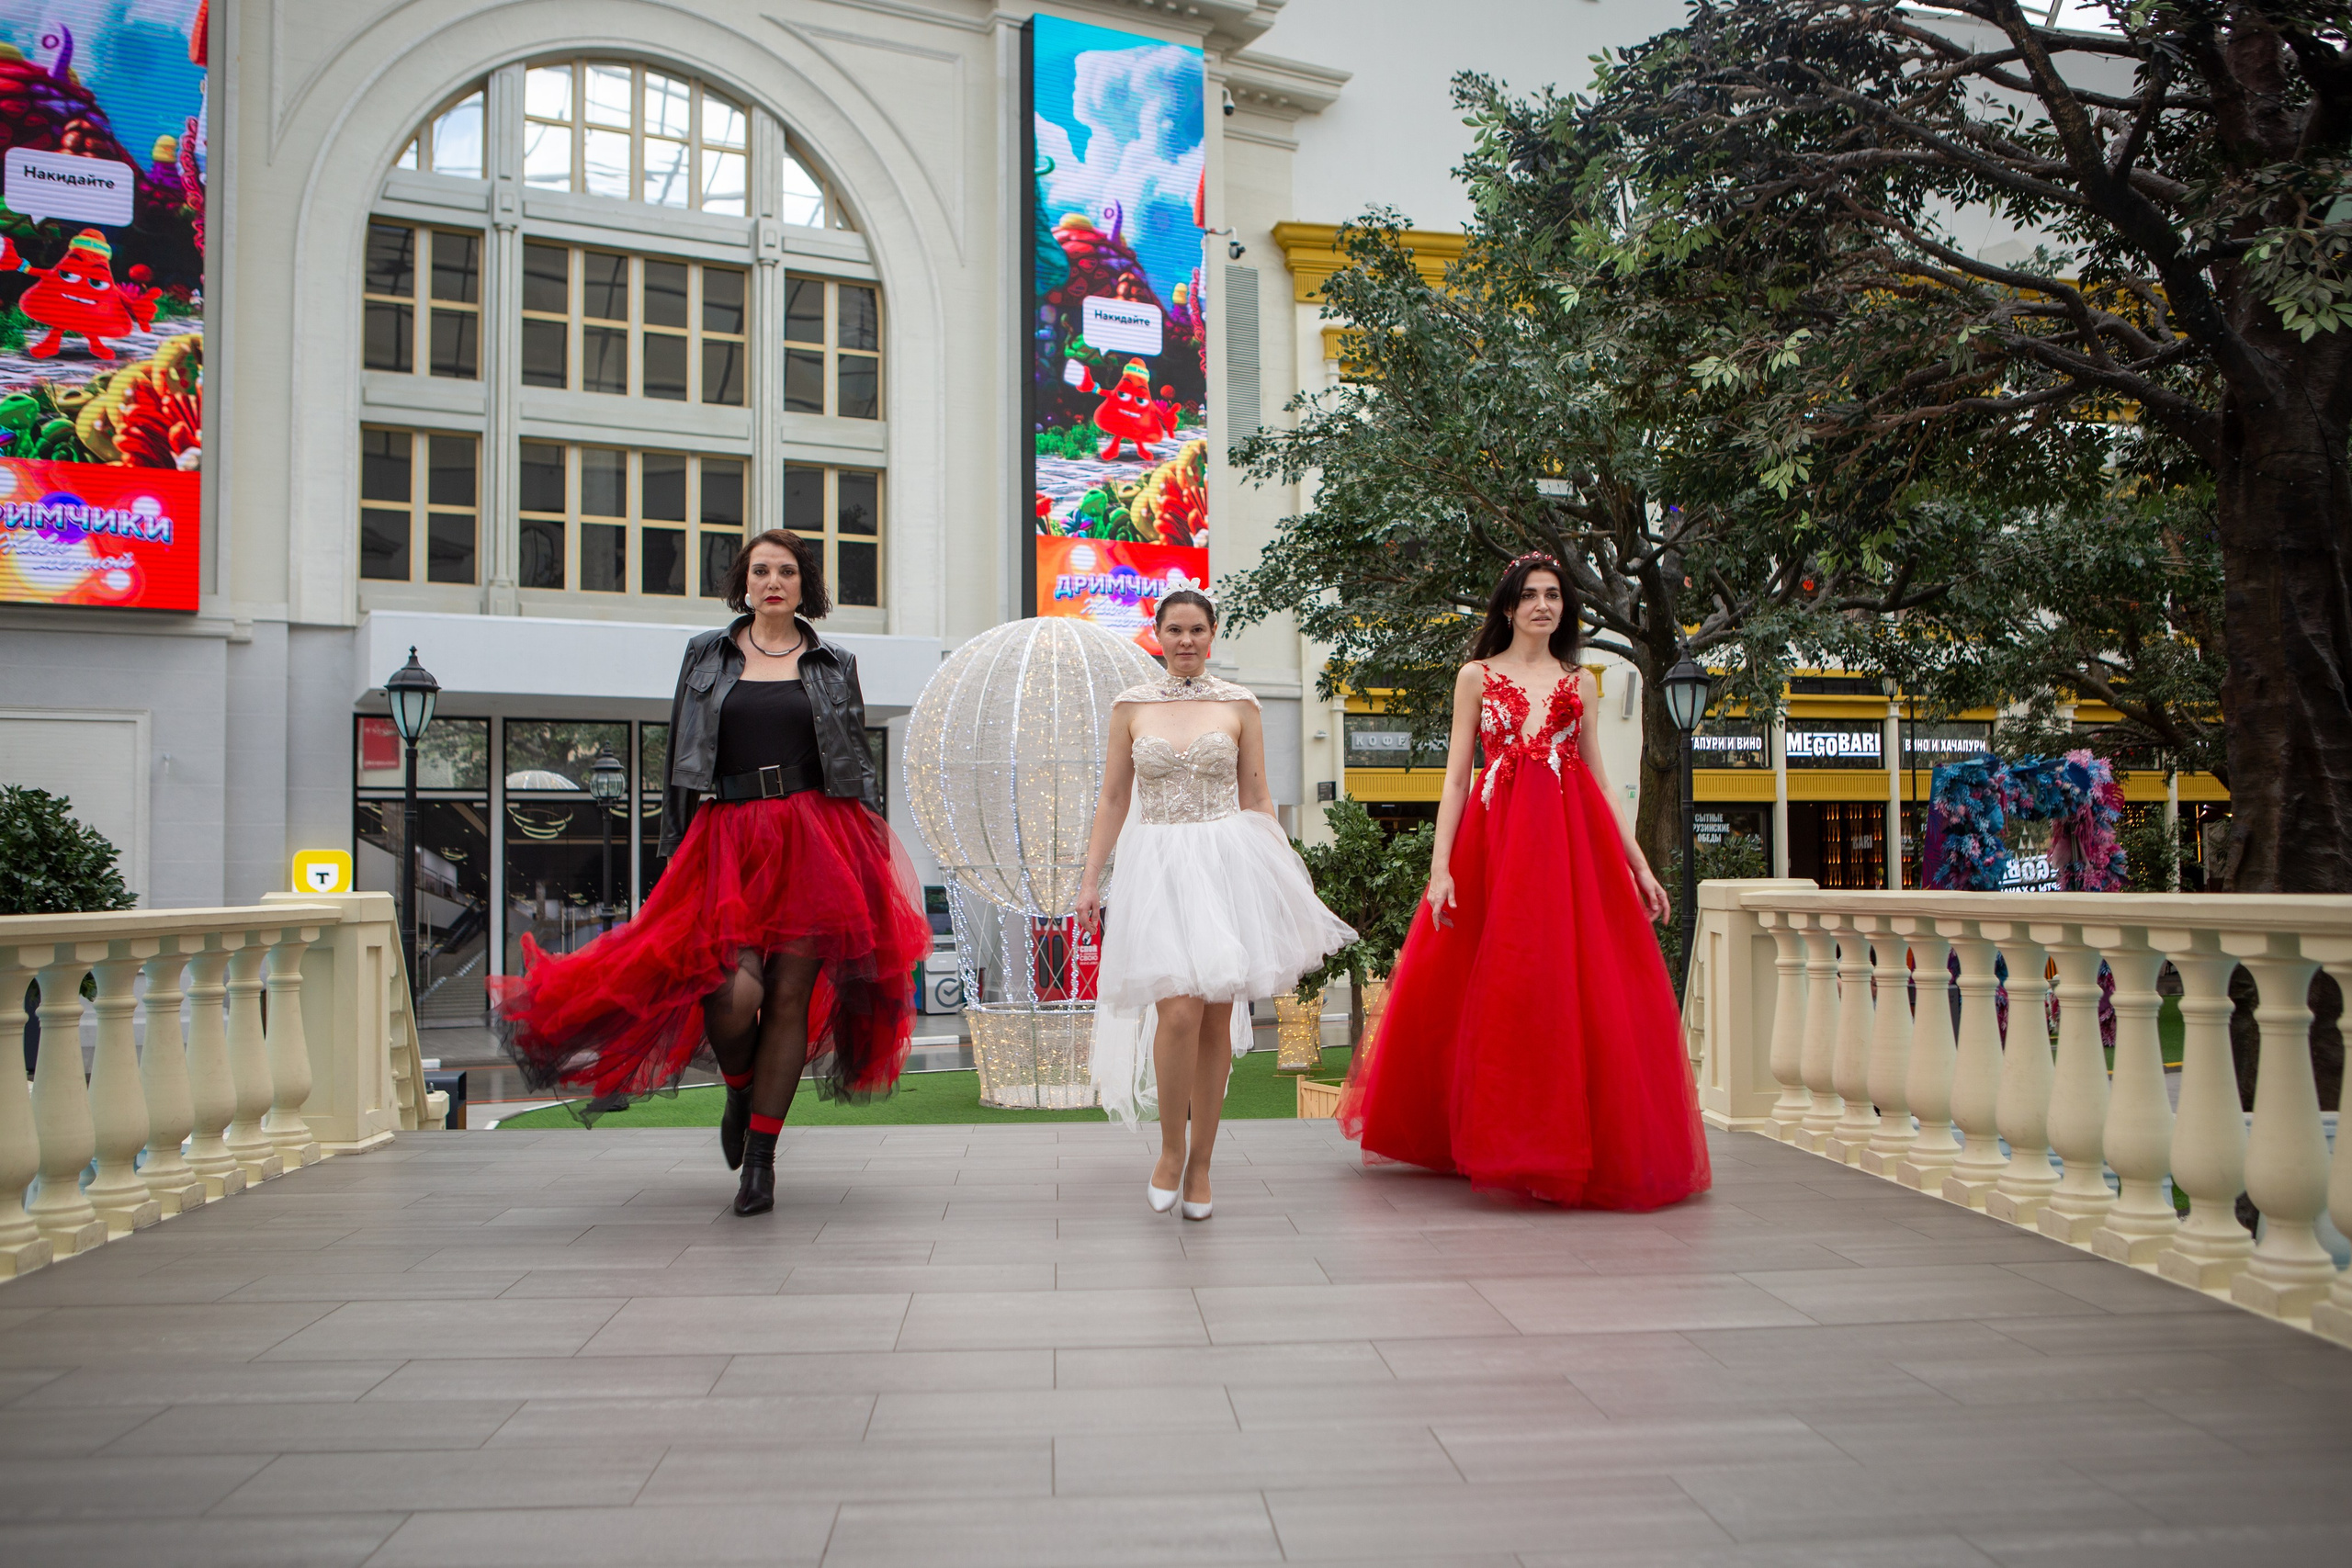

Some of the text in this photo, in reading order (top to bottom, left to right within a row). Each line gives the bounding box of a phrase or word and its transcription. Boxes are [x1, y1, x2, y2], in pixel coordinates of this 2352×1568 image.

[24, 165, 115, 189] Накидайте
[1094, 309, 1150, 326] Накидайте
[0, 502, 174, 546] ИМЧИКИ
[1690, 737, 1762, 750] АПУРИ И ВИНО
[1786, 732, 1881, 757] MEGOBARI
[1931, 739, 1939, 752] И
[1940, 739, 1986, 752] ХАЧАПУРИ
[1694, 813, 1724, 822] СЫТНЫЕ
[1692, 823, 1730, 832] РУЗИНСКИЕ
[1697, 833, 1722, 843] ОБЕДЫ
